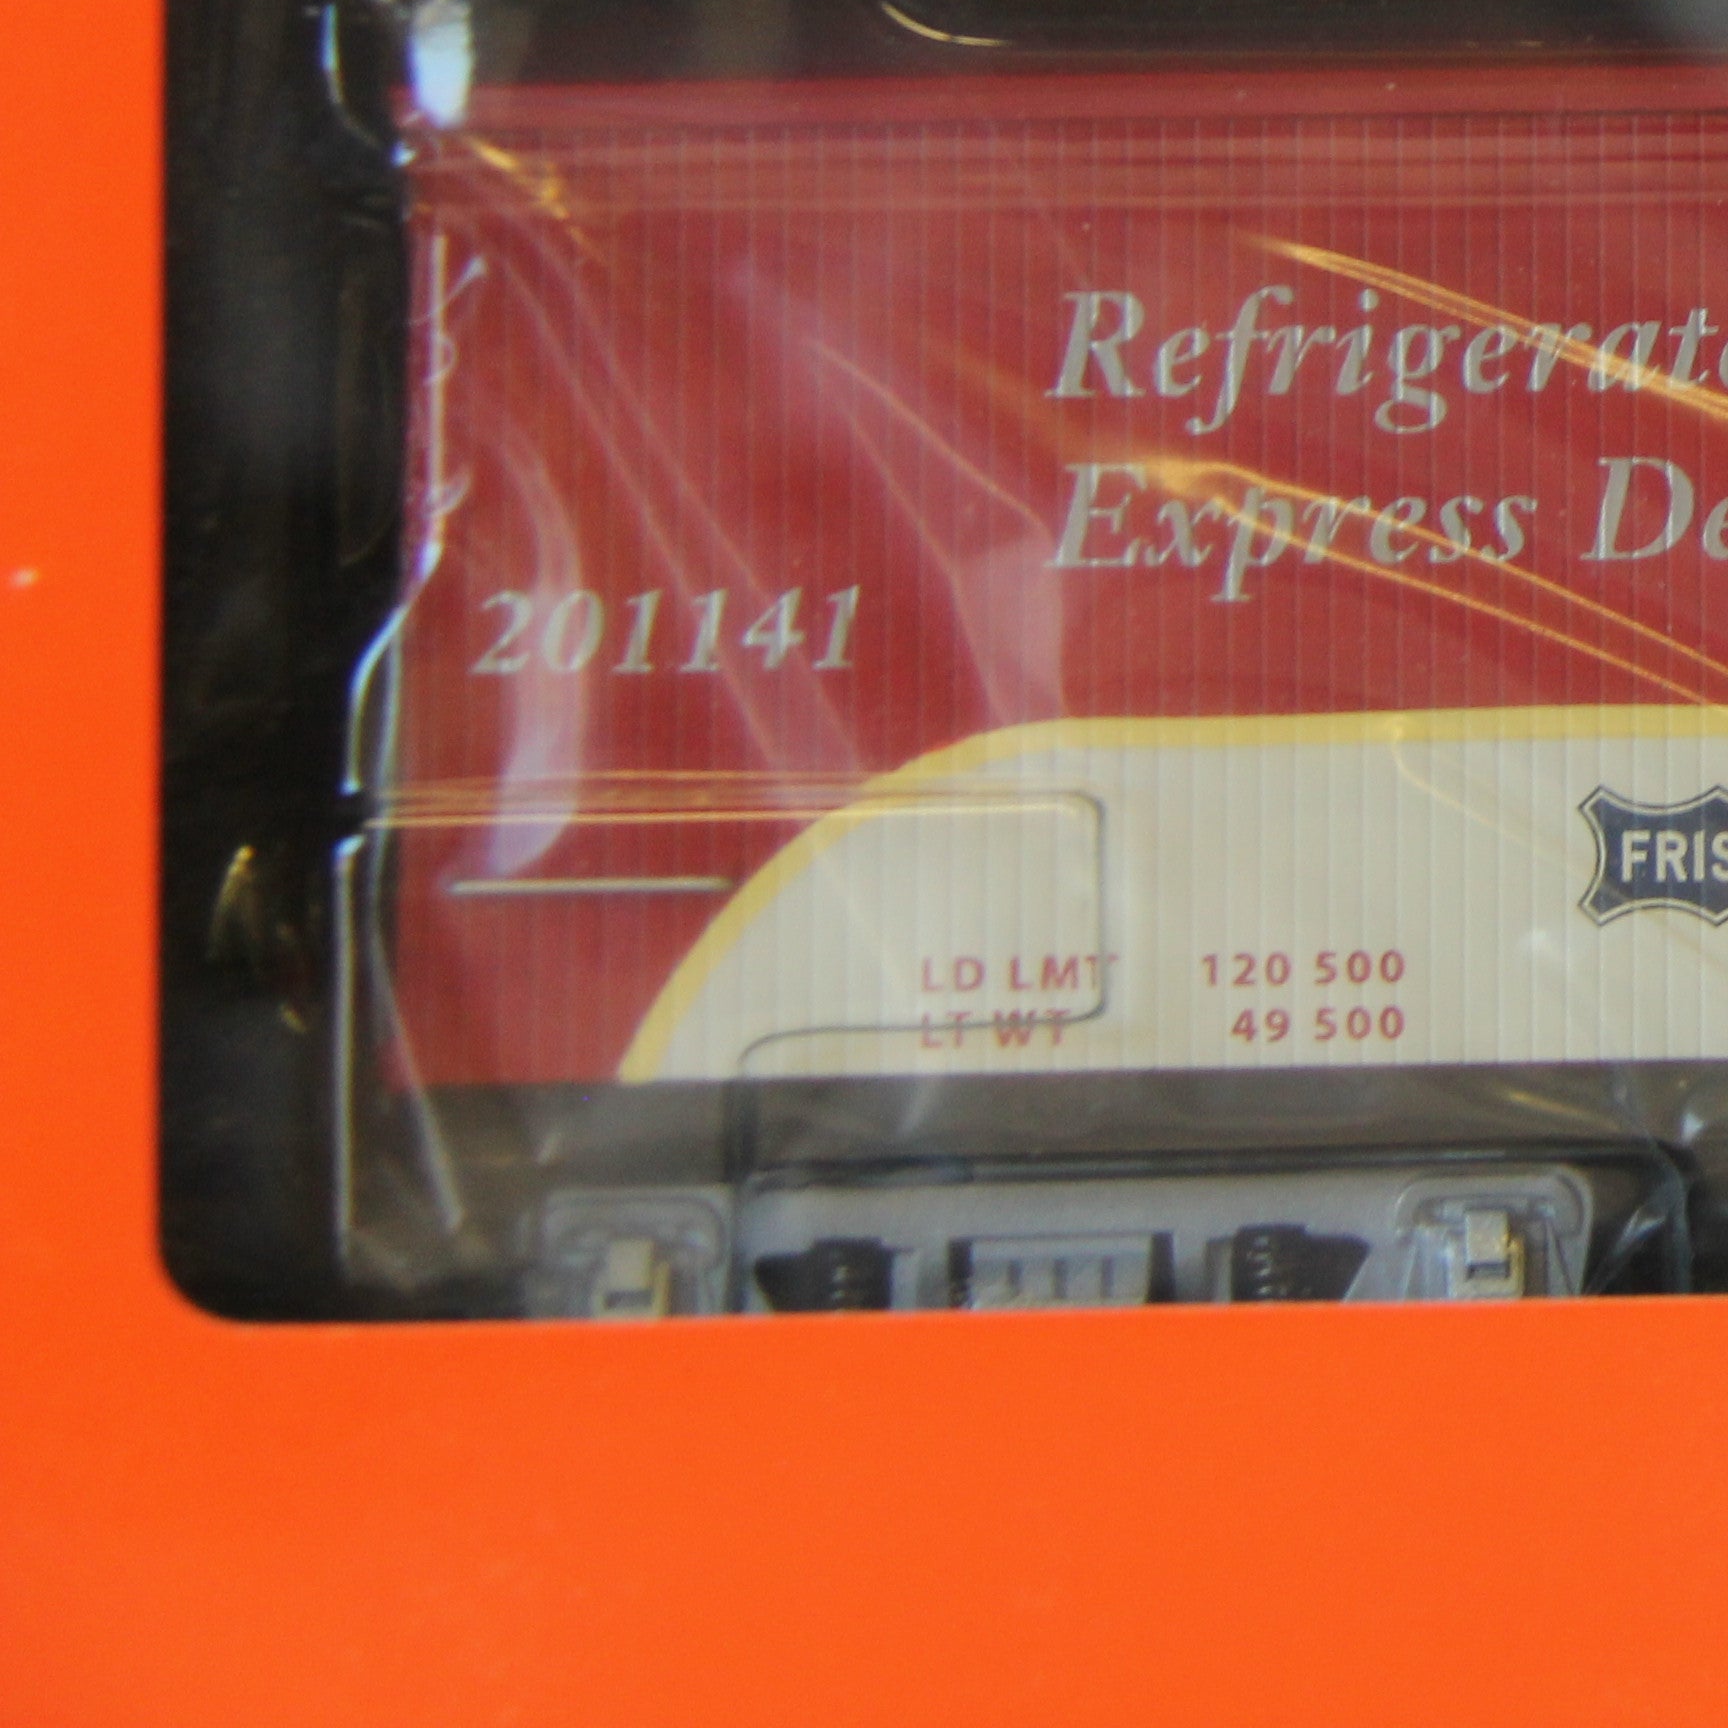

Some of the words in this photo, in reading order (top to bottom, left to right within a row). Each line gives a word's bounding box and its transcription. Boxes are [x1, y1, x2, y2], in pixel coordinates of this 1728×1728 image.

[1045, 460, 1540, 604] Express
[468, 582, 864, 675] 201141
[921, 956, 986, 992] LD
[1009, 955, 1118, 991] LMT
[1202, 953, 1293, 987] 120
[1314, 950, 1406, 985] 500
[920, 1010, 973, 1049] LT
[995, 1009, 1070, 1047] WT
[1231, 1009, 1292, 1042] 49
[1314, 1006, 1406, 1041] 500
